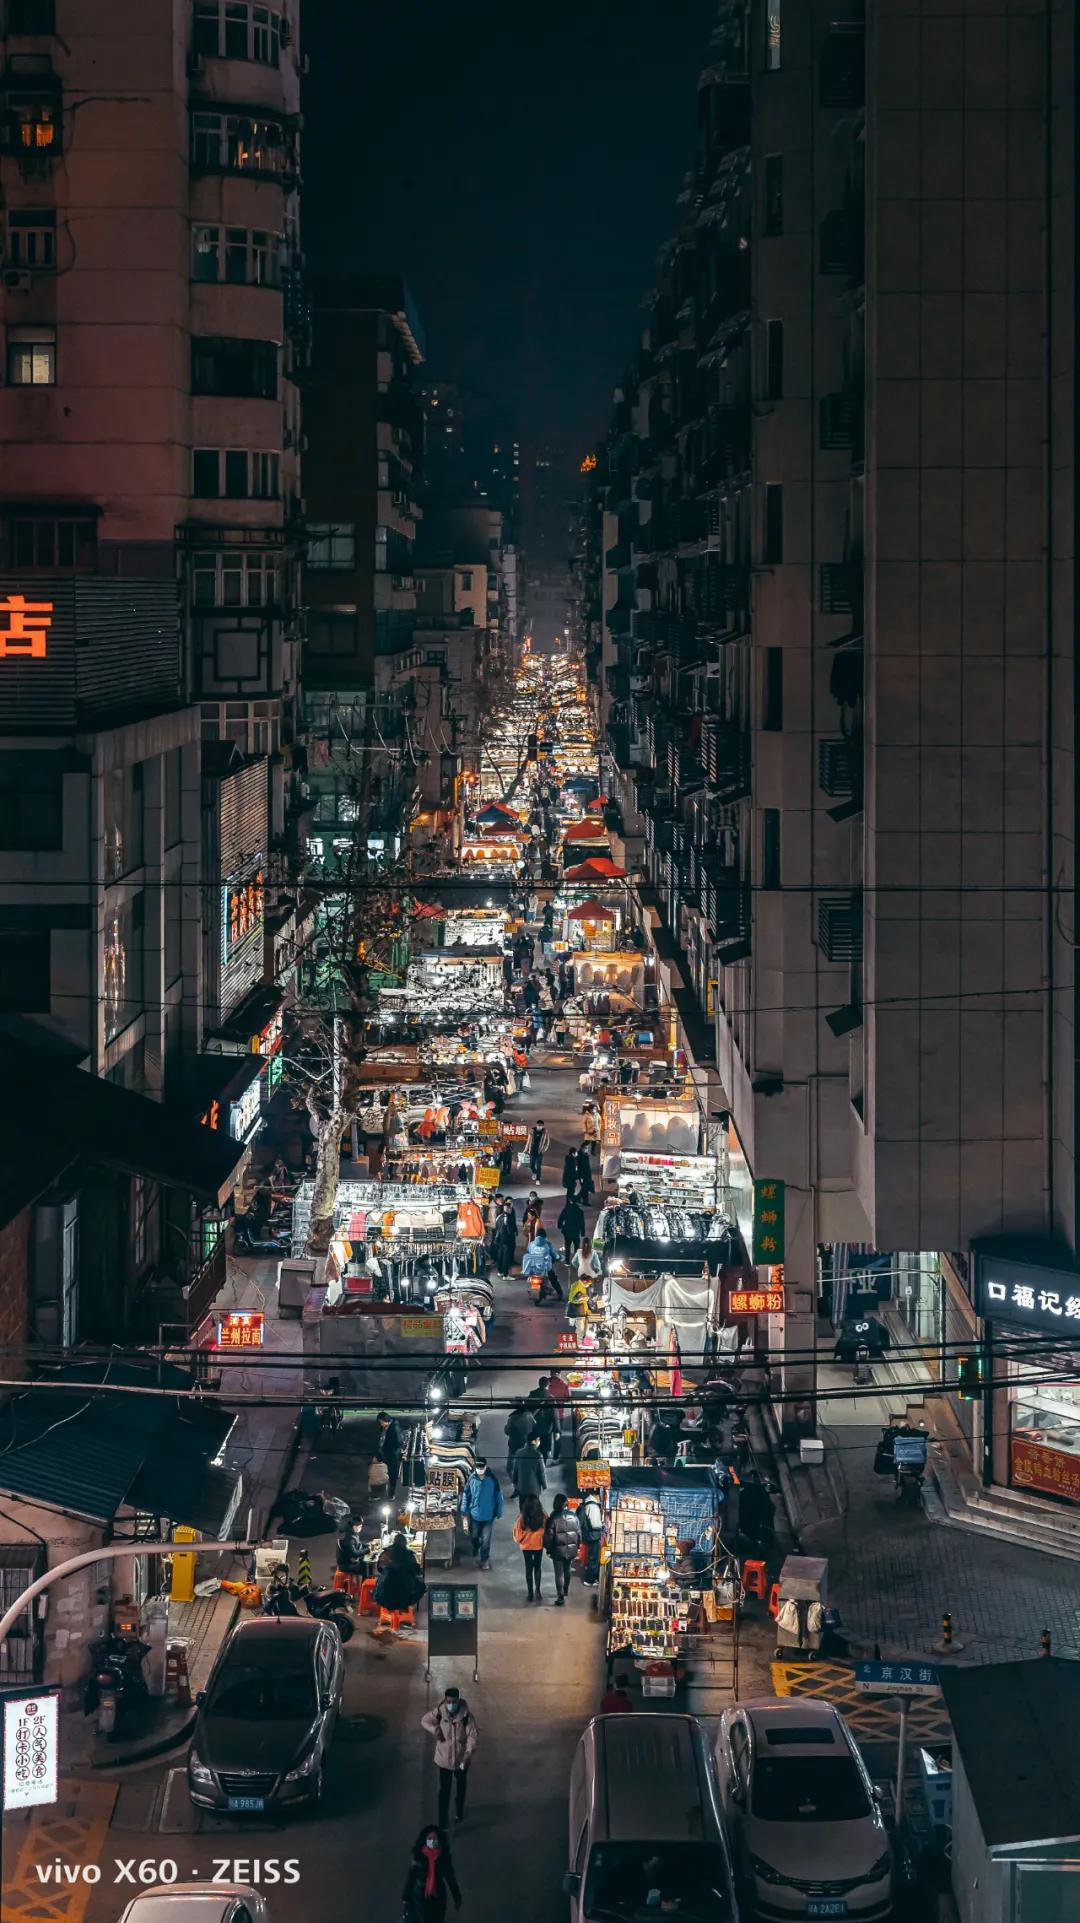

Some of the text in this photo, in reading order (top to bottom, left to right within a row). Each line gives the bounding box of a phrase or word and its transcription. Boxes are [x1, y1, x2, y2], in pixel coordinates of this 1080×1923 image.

[0, 595, 54, 658] 店
[503, 1124, 528, 1136] 贴膜
[607, 1103, 619, 1145] 化妆品
[761, 1183, 777, 1252] 螺蛳粉
[732, 1293, 782, 1311] 螺蛳粉
[221, 1327, 262, 1345] 兰州拉面
[428, 1470, 455, 1487] 贴膜
[880, 1666, 932, 1682] 京汉街
[18, 1714, 46, 1727] 1F 2F
[16, 1728, 30, 1780] 打卡小吃
[33, 1726, 46, 1778] 人气美食
